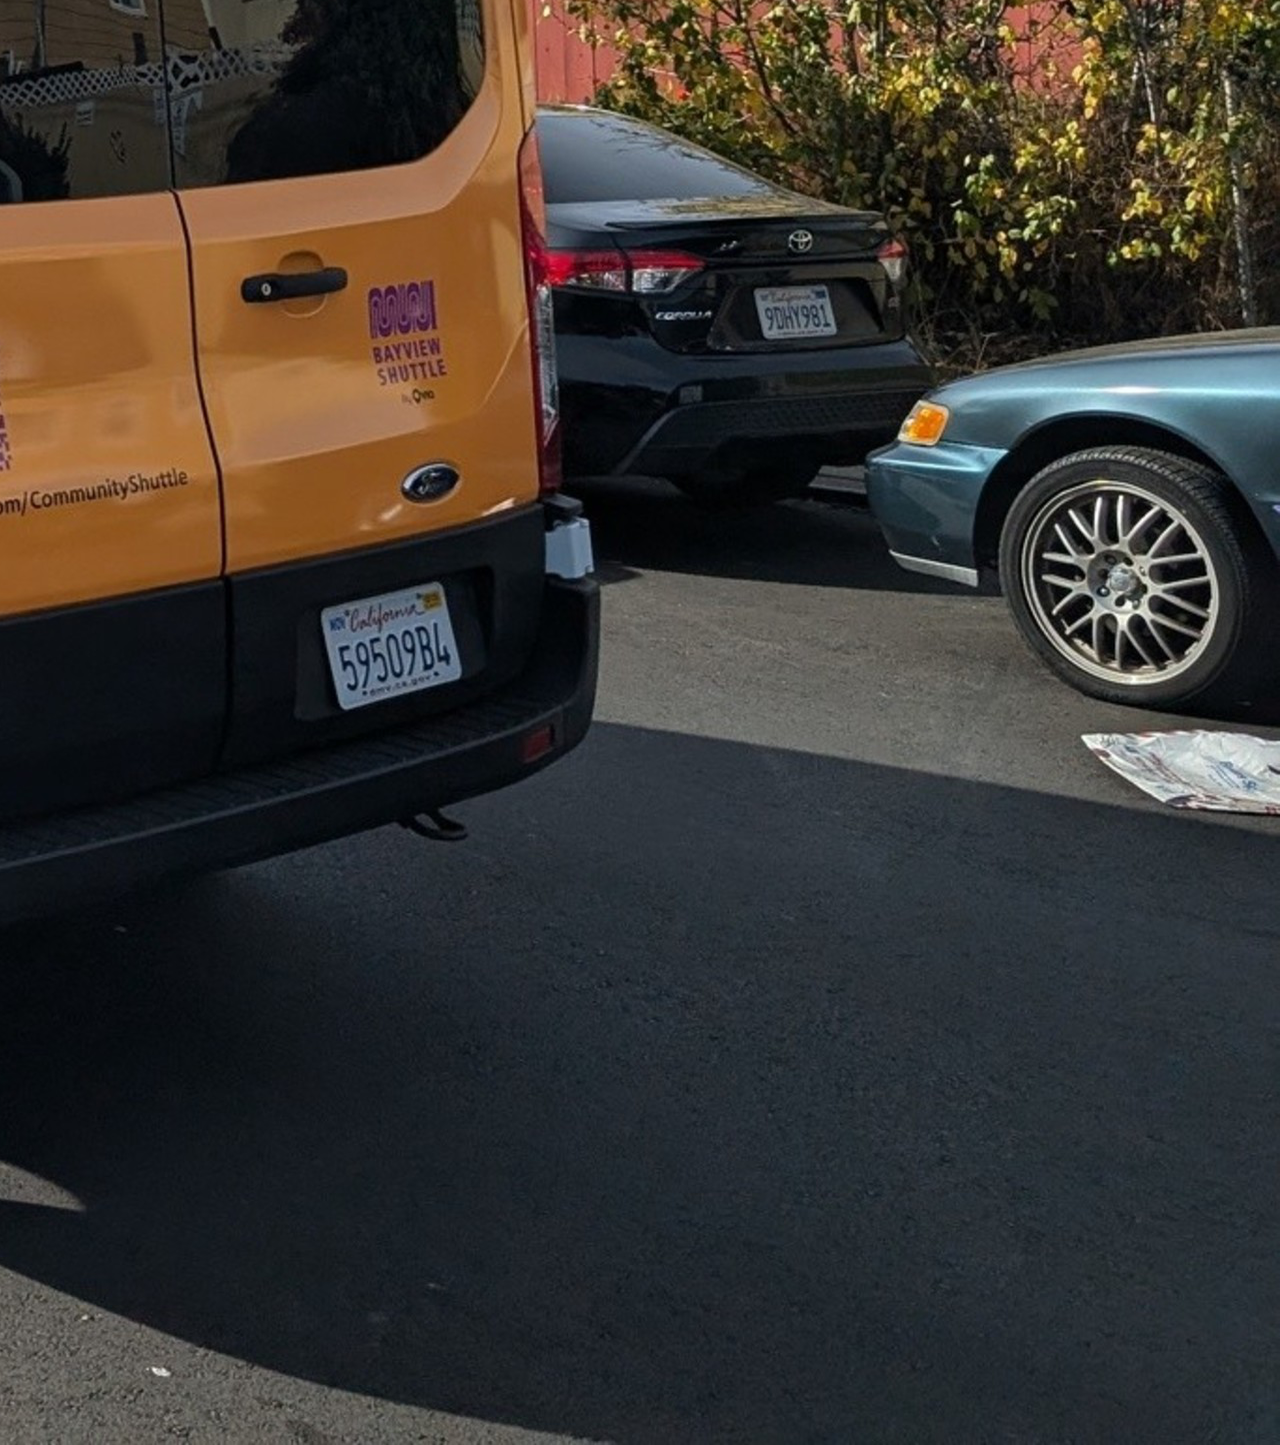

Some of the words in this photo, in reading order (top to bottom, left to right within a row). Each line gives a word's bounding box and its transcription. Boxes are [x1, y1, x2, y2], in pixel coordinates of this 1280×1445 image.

[764, 303, 832, 331] 9DHY981
[372, 337, 441, 365] BAYVIEW
[377, 358, 448, 387] SHUTTLE
[349, 603, 425, 633] California
[338, 622, 451, 691] 59509B4
